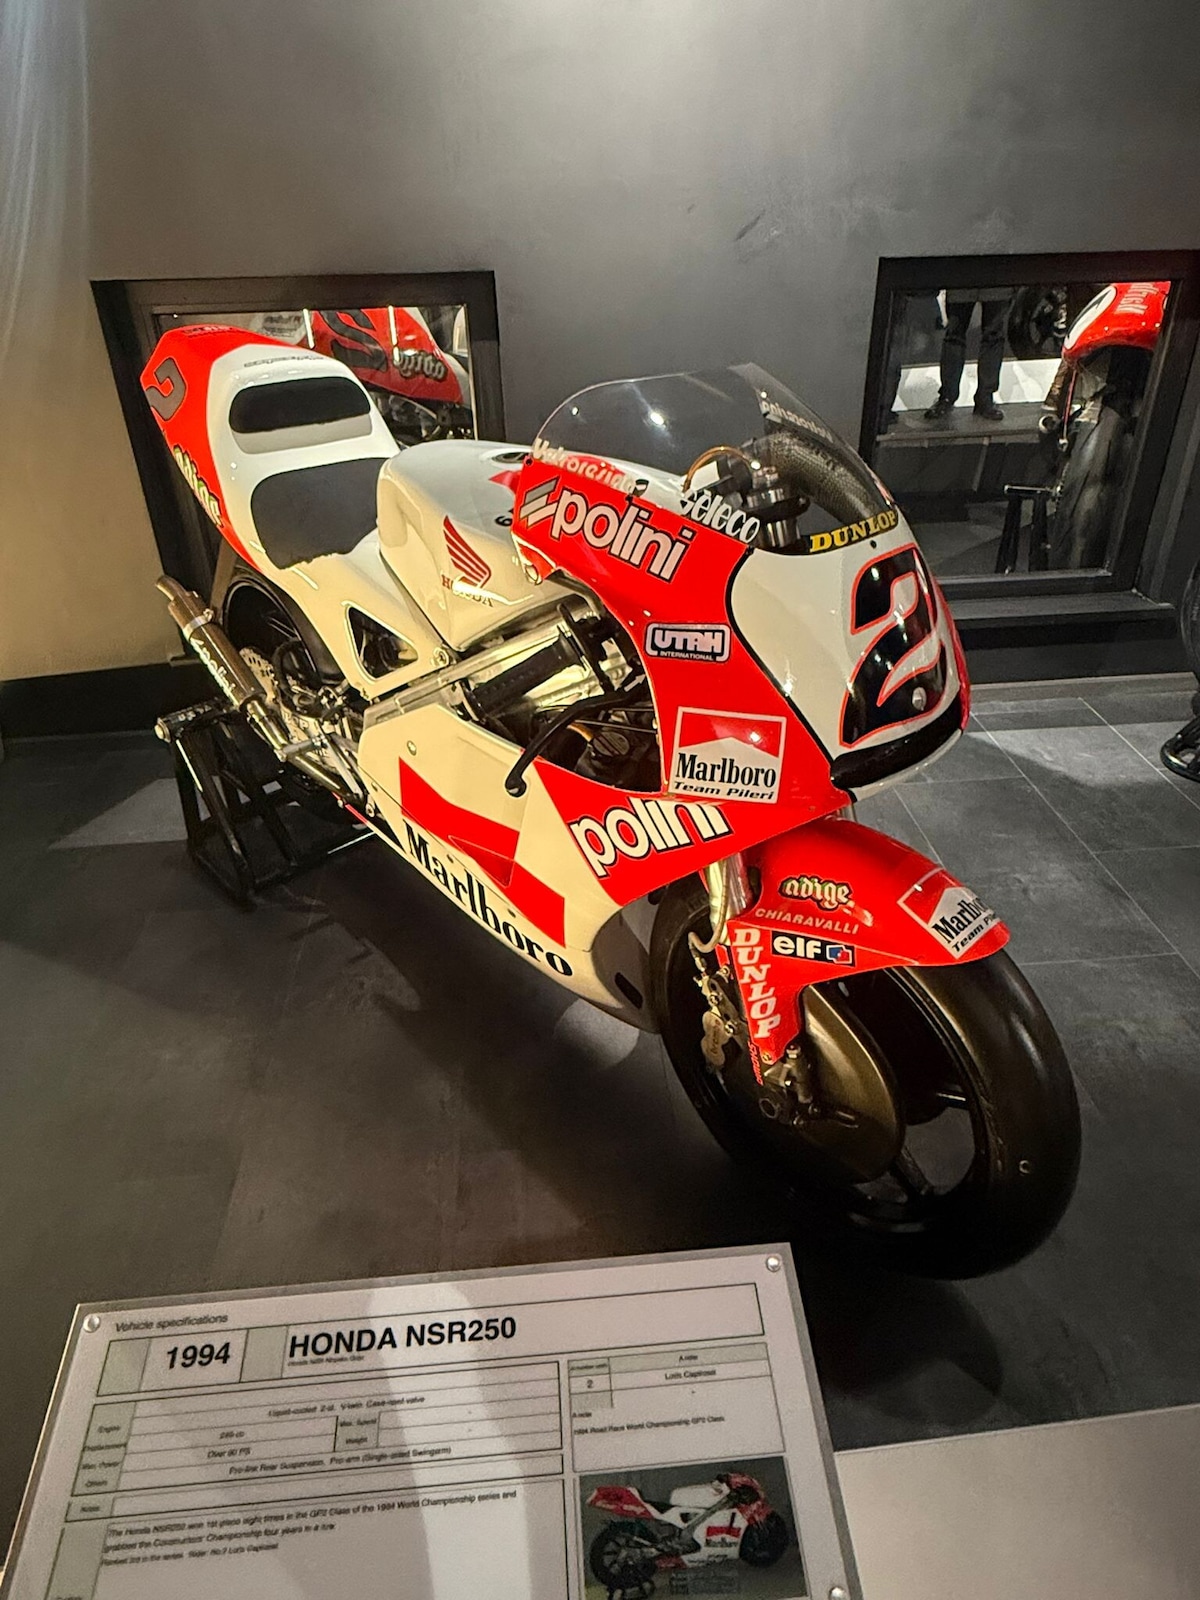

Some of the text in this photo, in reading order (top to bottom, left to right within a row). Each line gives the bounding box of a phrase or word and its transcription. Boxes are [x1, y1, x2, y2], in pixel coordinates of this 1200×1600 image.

[551, 488, 695, 582] polini
[810, 509, 898, 552] DUNLOP
[654, 629, 723, 654] UTAH
[839, 543, 947, 748] 2
[660, 651, 714, 661] INTERNATIONAL
[675, 752, 776, 788] Marlboro
[674, 781, 774, 800] Team Pileri
[570, 797, 733, 878] polini
[402, 818, 573, 976] Marlboro
[755, 907, 860, 935] CHIARAVALLI
[773, 936, 822, 959] elf
[952, 924, 984, 952] Team
[733, 928, 780, 1038] DUNLOP
[116, 1314, 228, 1332] Vehicle specifications
[289, 1317, 517, 1358] HONDA NSR250
[167, 1342, 231, 1369] 1994
[587, 1379, 593, 1388] 2
[502, 1490, 517, 1499] and
